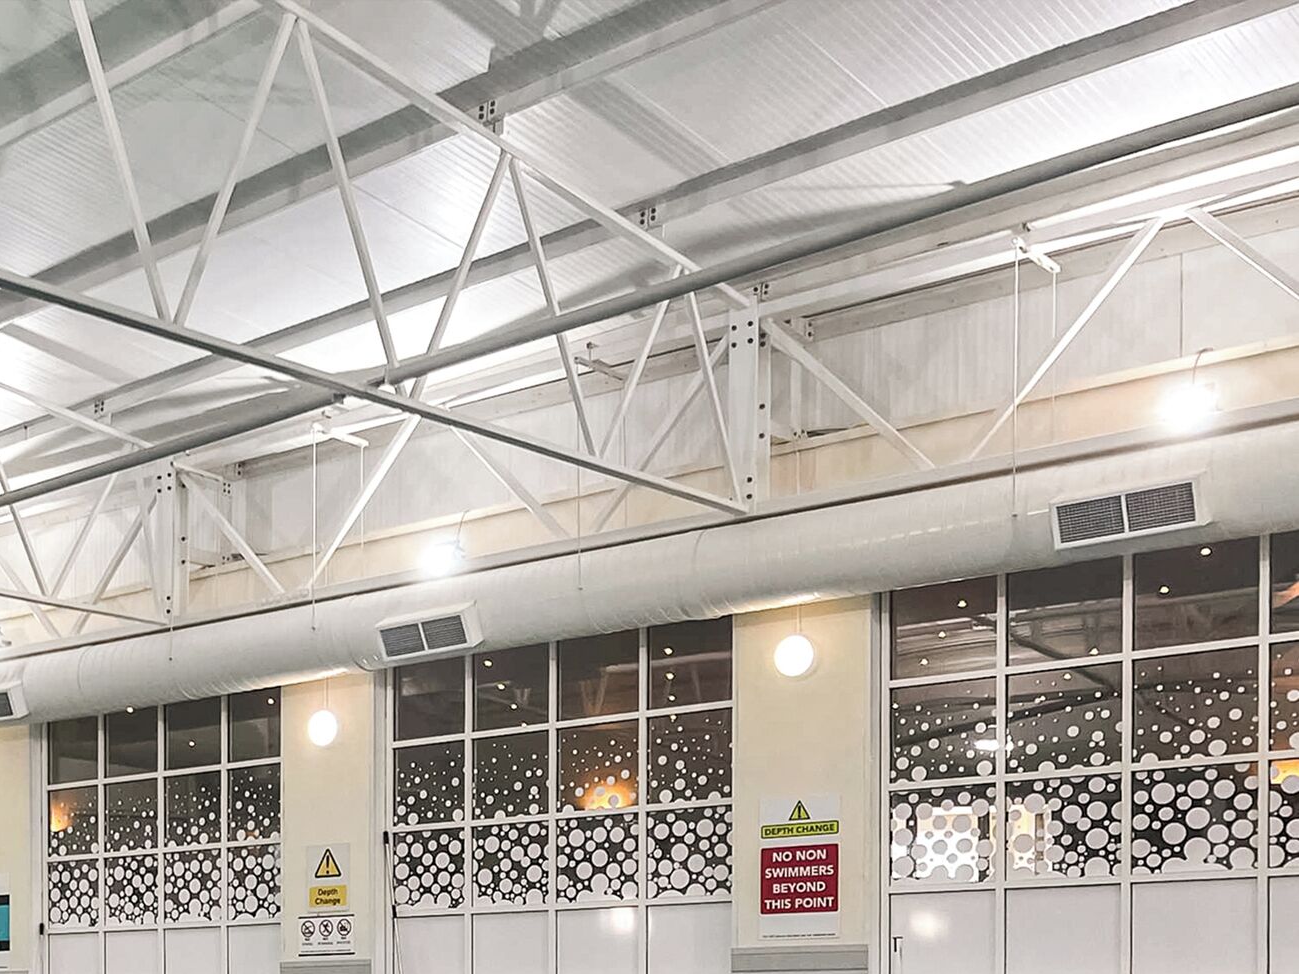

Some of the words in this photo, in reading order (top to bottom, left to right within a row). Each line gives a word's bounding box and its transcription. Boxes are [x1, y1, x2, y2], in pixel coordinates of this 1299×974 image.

[764, 827, 793, 836] DEPTH
[796, 824, 835, 833] CHANGE
[772, 851, 792, 862] NO
[796, 849, 827, 861] NON
[765, 864, 834, 879] SWIMMERS
[318, 887, 338, 896] Depth
[772, 881, 826, 894] BEYOND
[315, 897, 341, 906] Change
[764, 899, 791, 910] THIS
[795, 897, 834, 908] POINT
